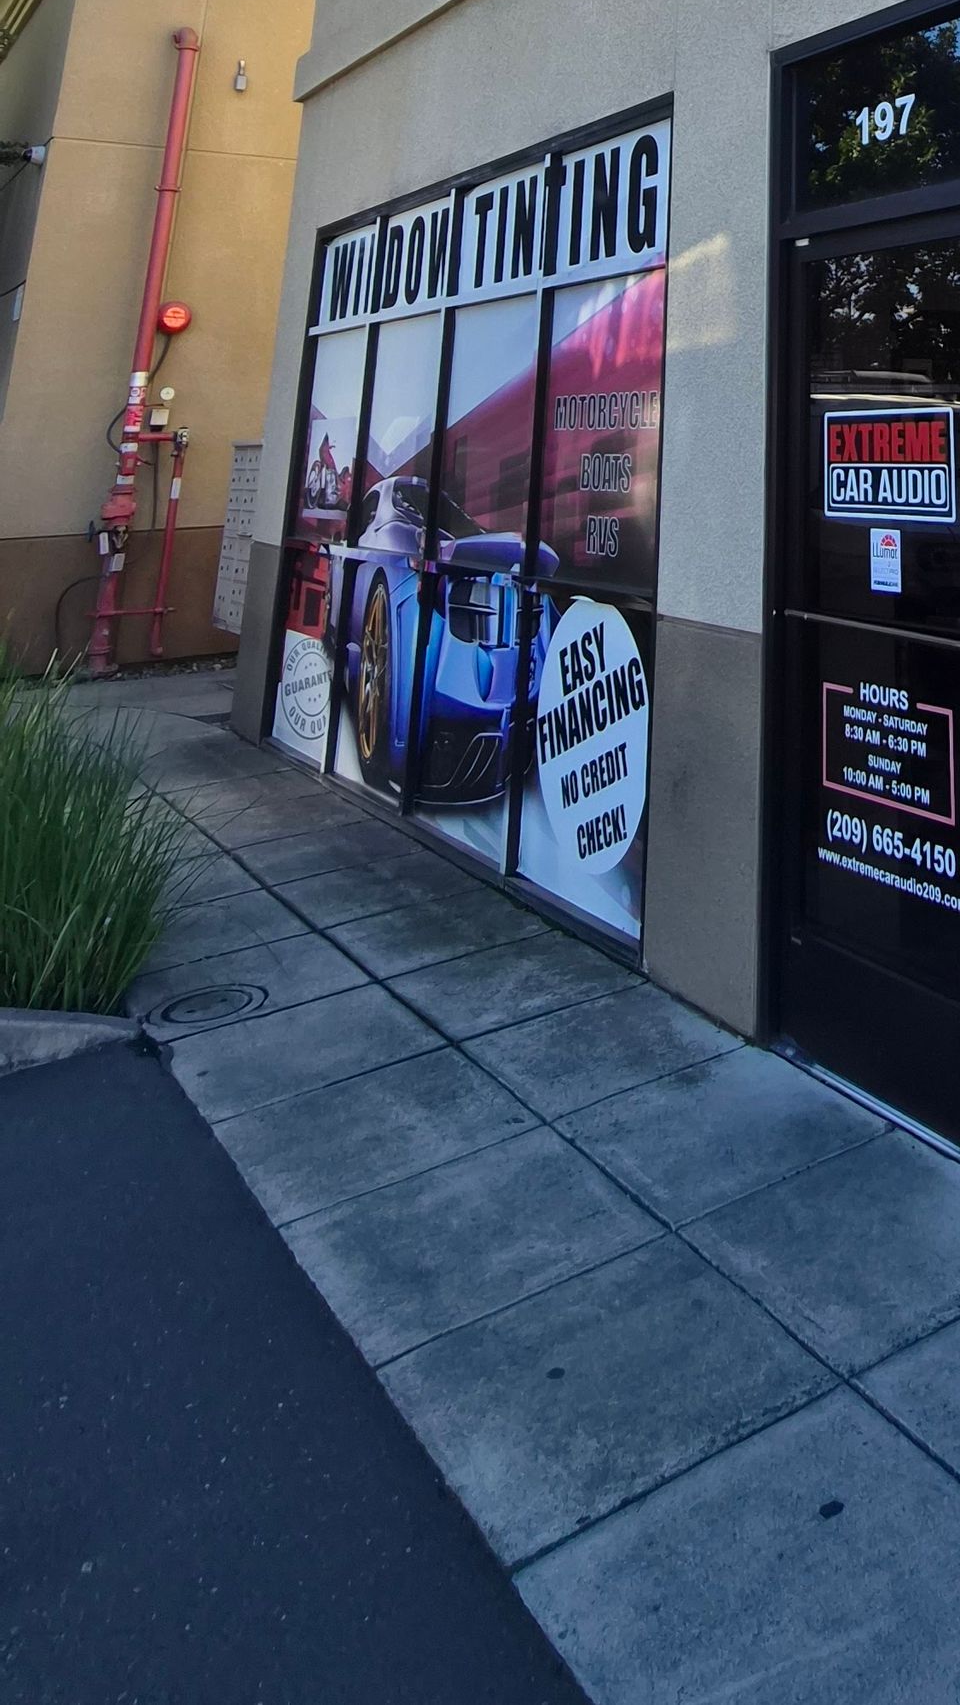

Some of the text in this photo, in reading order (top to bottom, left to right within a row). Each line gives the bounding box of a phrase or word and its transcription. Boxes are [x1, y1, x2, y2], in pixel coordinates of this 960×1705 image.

[854, 94, 916, 145] 197
[474, 135, 659, 288] TINTING
[554, 390, 658, 430] MOTORCYCLE
[829, 421, 948, 462] EXTREME
[580, 453, 632, 493] BOATS
[832, 468, 946, 505] CAR AUDIO
[586, 515, 619, 557] RVS
[286, 649, 300, 671] OUR
[559, 621, 606, 696] EASY
[538, 657, 646, 765] FINANCING
[859, 681, 909, 710] HOURS
[288, 706, 307, 732] OUR
[843, 705, 877, 724] MONDAY
[883, 714, 928, 736] SATURDAY
[844, 724, 864, 741] 8:30
[865, 729, 881, 746] AM
[888, 734, 908, 752] 6:30
[910, 741, 927, 758] PM
[561, 742, 629, 809] NO CREDIT
[868, 754, 902, 775] SUNDAY
[843, 767, 867, 785] 10:00
[868, 774, 884, 791] AM
[891, 780, 912, 799] 5:00
[914, 786, 930, 806] PM
[577, 804, 628, 860] CHECK!
[826, 809, 956, 878] (209) 665-4150
